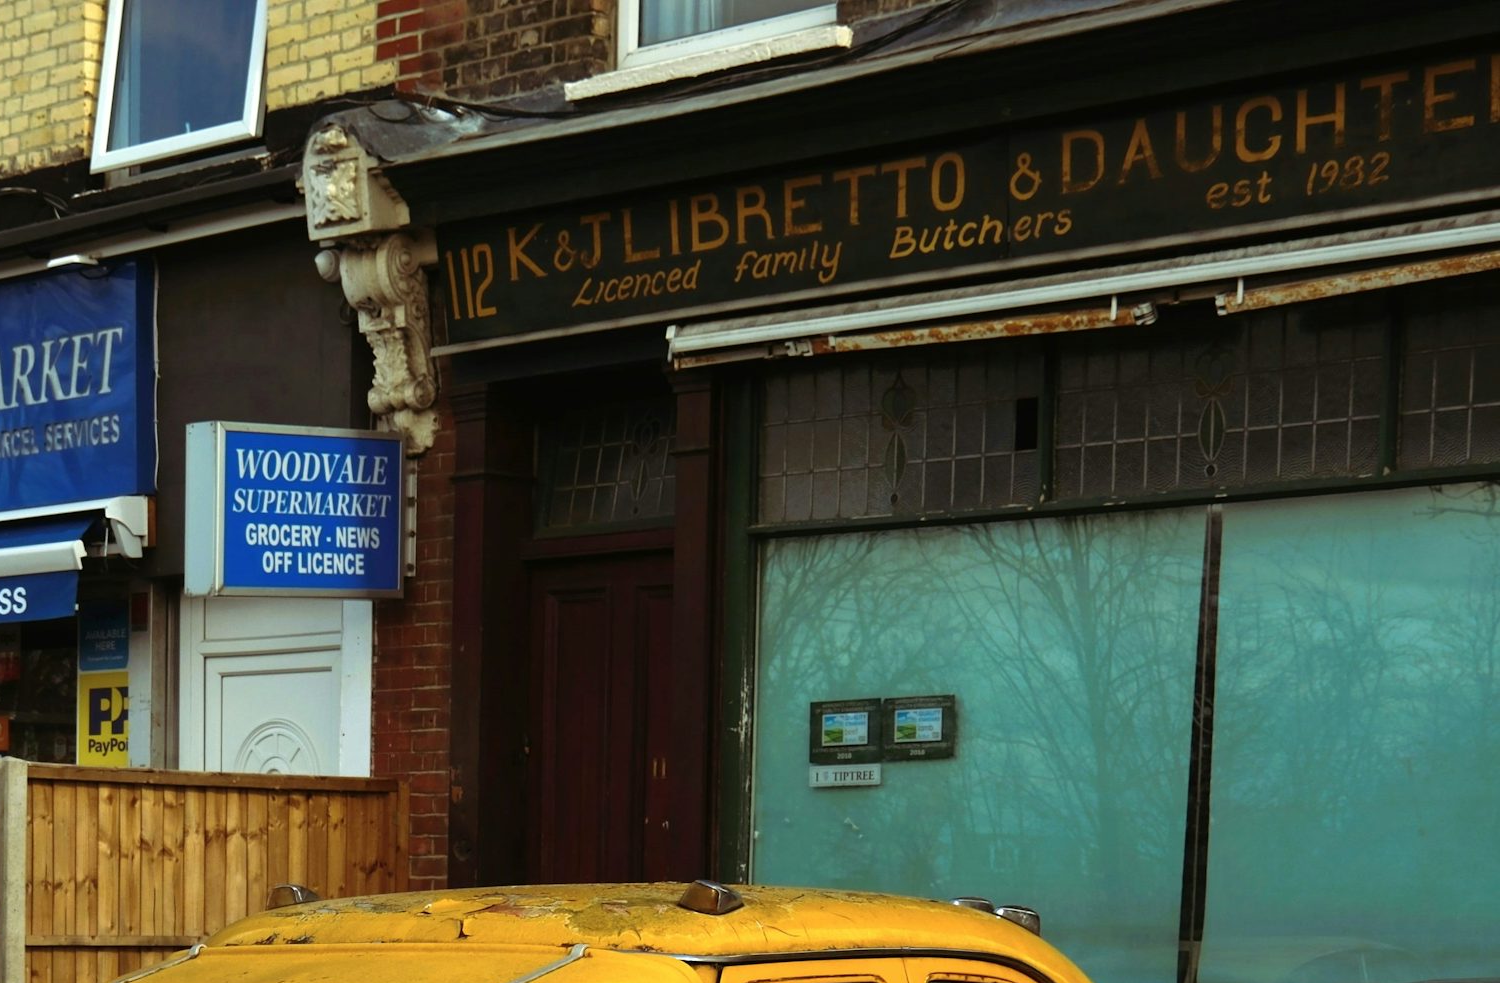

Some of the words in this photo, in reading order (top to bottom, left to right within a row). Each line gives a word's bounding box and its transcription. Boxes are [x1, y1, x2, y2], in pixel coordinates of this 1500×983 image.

[445, 242, 498, 321] 112
[622, 152, 966, 264] LIBRETTO
[1009, 152, 1042, 201] &
[1061, 53, 1500, 195] DAUGHTE
[572, 260, 702, 309] Licenced
[889, 209, 1073, 260] Butchers
[1205, 170, 1273, 210] est
[1306, 151, 1391, 196] 1982
[45, 414, 120, 452] SERVICES
[235, 447, 389, 486] WOODVALE
[232, 487, 392, 518] SUPERMARKET
[245, 523, 323, 547] GROCERY
[335, 526, 380, 549] NEWS
[262, 551, 293, 573] OFF
[297, 552, 365, 575] LICENCE
[84, 627, 127, 640] AVAILABLE
[94, 640, 116, 650] HERE
[832, 770, 876, 782] TIPTREE
